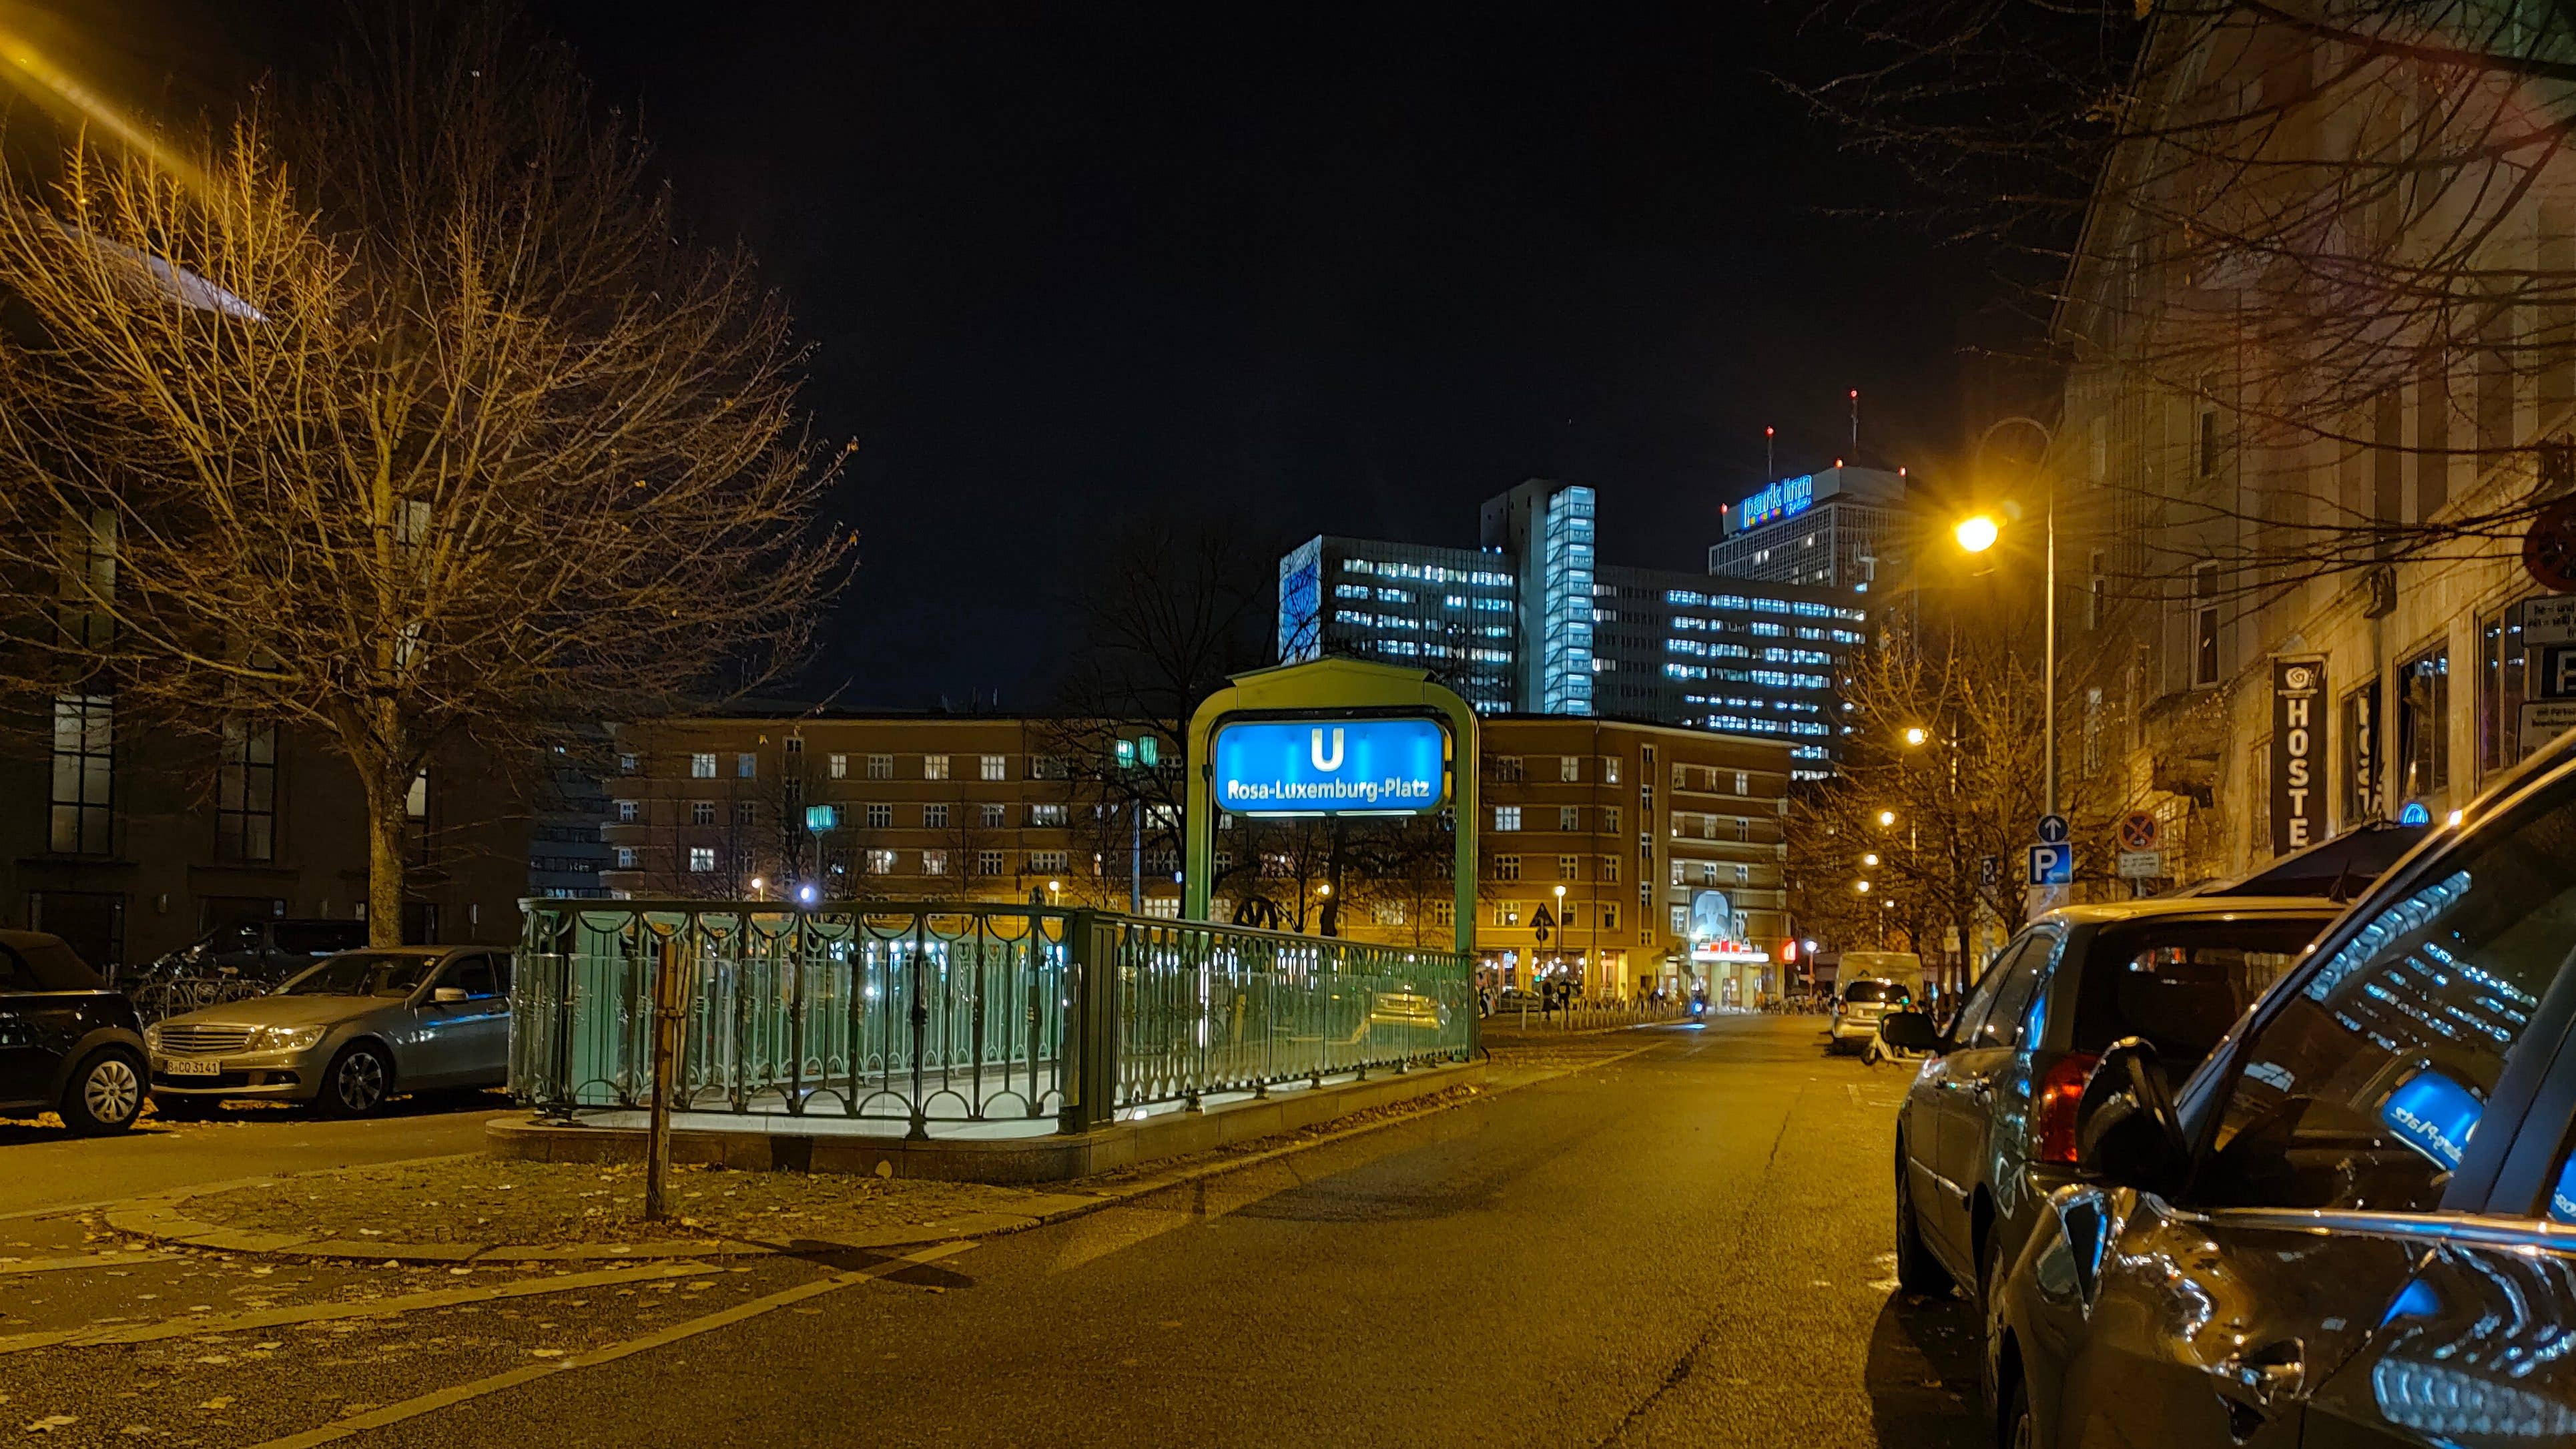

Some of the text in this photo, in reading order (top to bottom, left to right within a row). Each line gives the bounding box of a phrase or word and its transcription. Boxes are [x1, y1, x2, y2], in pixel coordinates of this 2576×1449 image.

[1311, 728, 1345, 772] U
[1227, 777, 1430, 803] Rosa-Luxemburg-Platz
[2288, 699, 2310, 848] HOSTE
[2035, 848, 2058, 882] P
[193, 1062, 217, 1073] 3141
